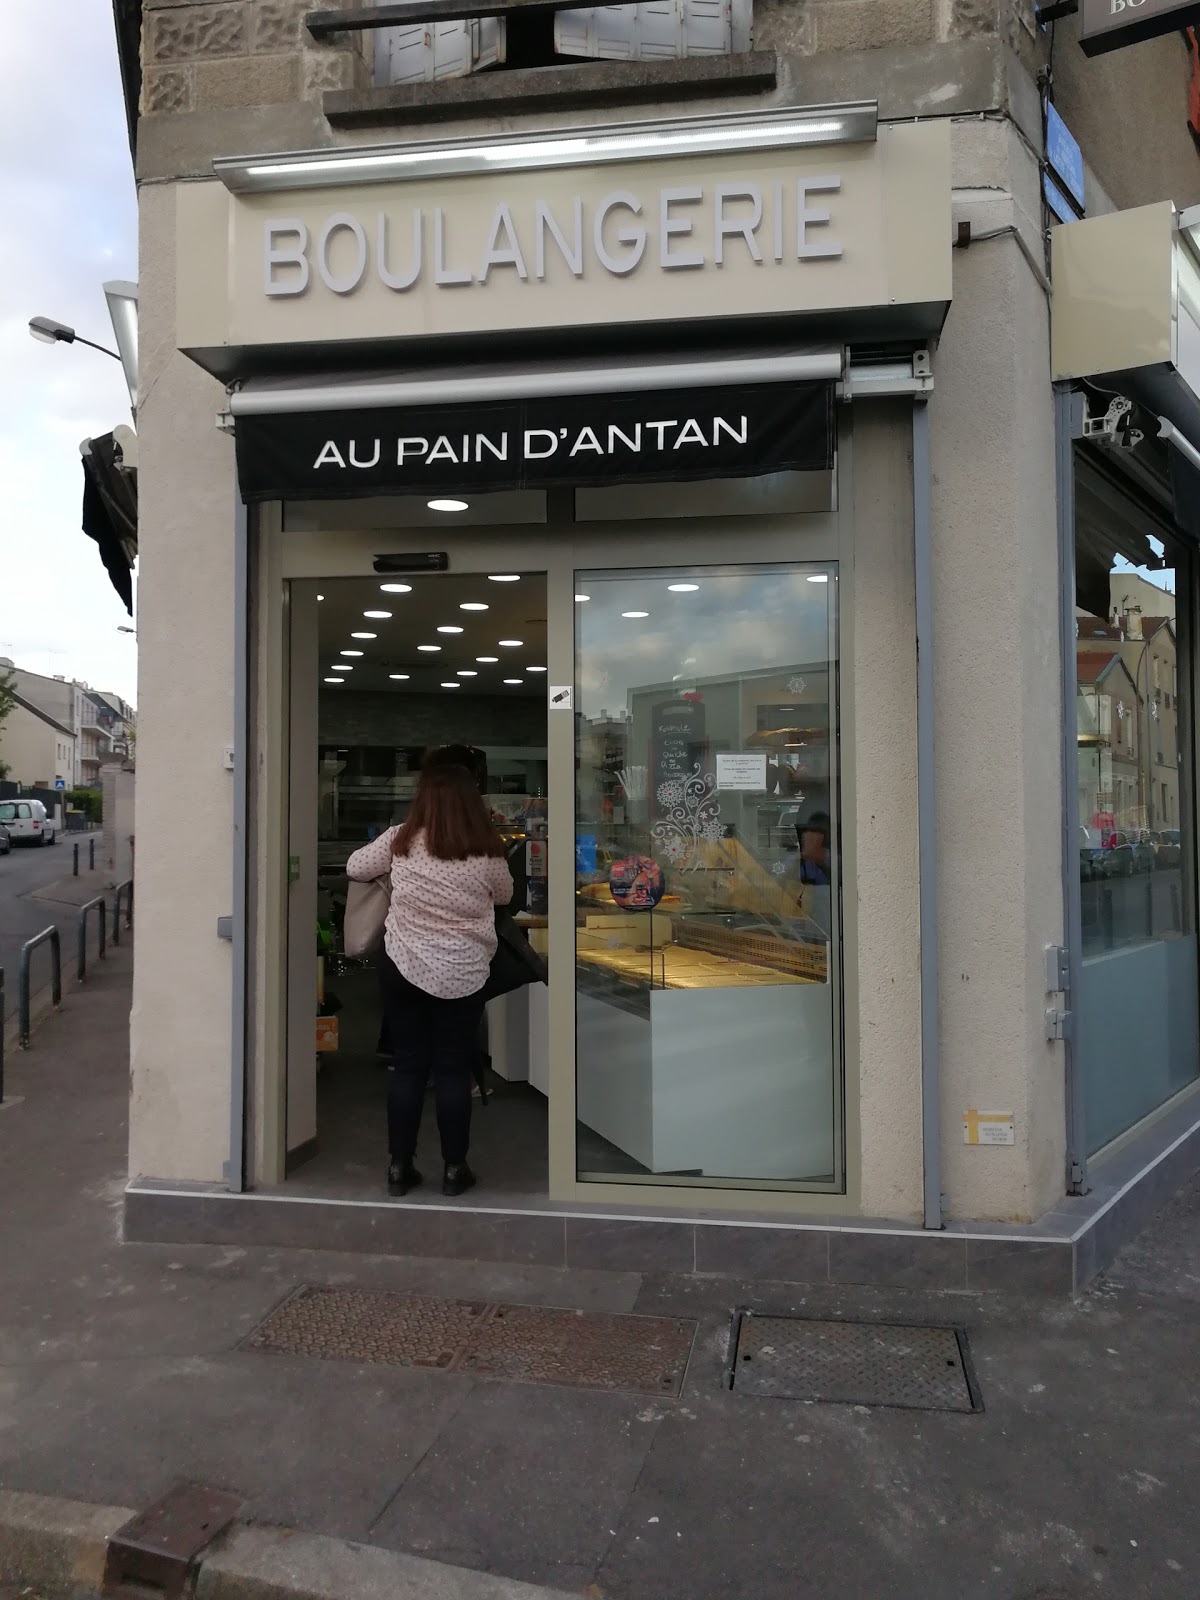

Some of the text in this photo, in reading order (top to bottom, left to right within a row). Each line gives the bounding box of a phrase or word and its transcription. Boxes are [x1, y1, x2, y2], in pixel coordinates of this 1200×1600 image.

[263, 174, 844, 298] BOULANGERIE
[313, 415, 748, 469] AU PAIN D'ANTAN
